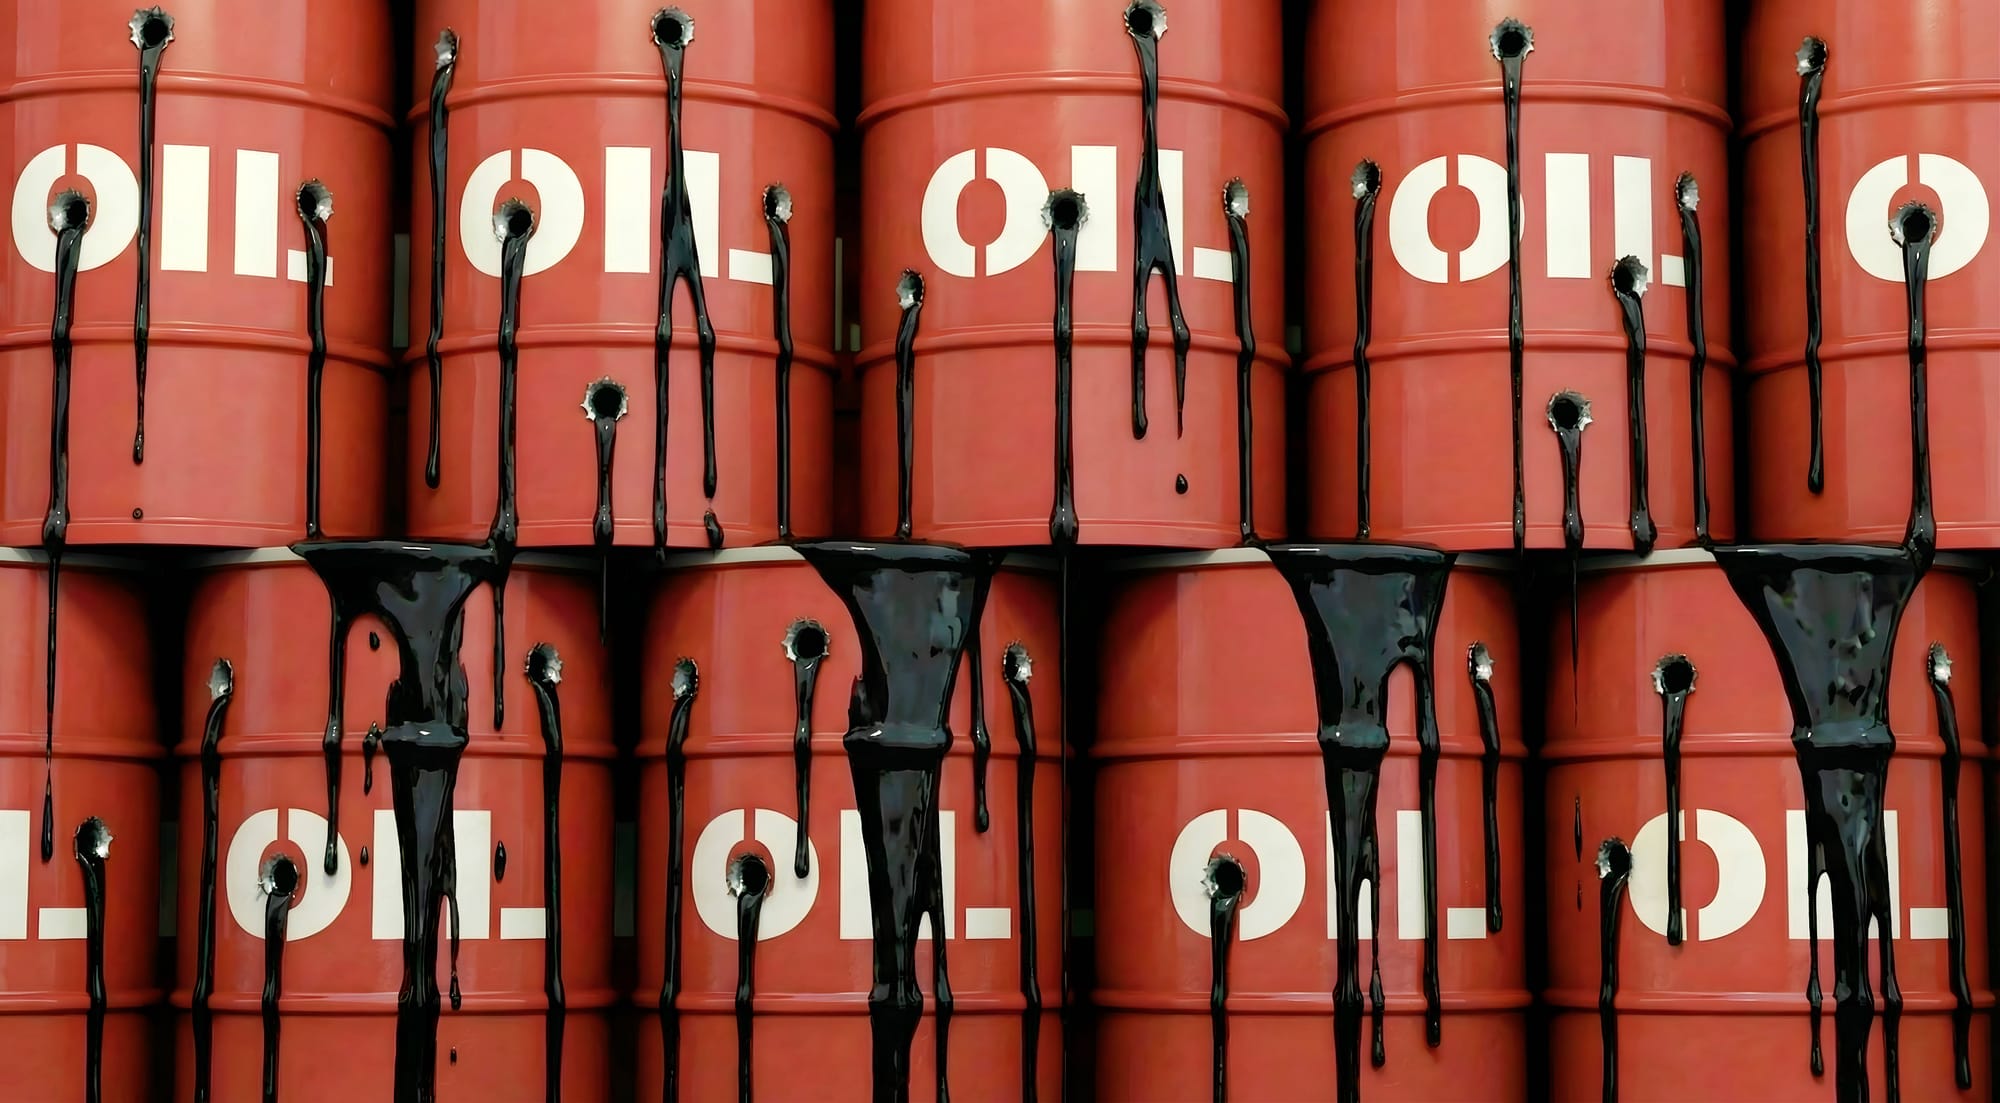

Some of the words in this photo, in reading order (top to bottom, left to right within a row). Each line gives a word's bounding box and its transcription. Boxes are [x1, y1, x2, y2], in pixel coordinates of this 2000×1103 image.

[11, 143, 334, 286] OIL
[460, 148, 773, 286] OIL
[921, 145, 1234, 284] OIL
[1389, 152, 1686, 288] OIL
